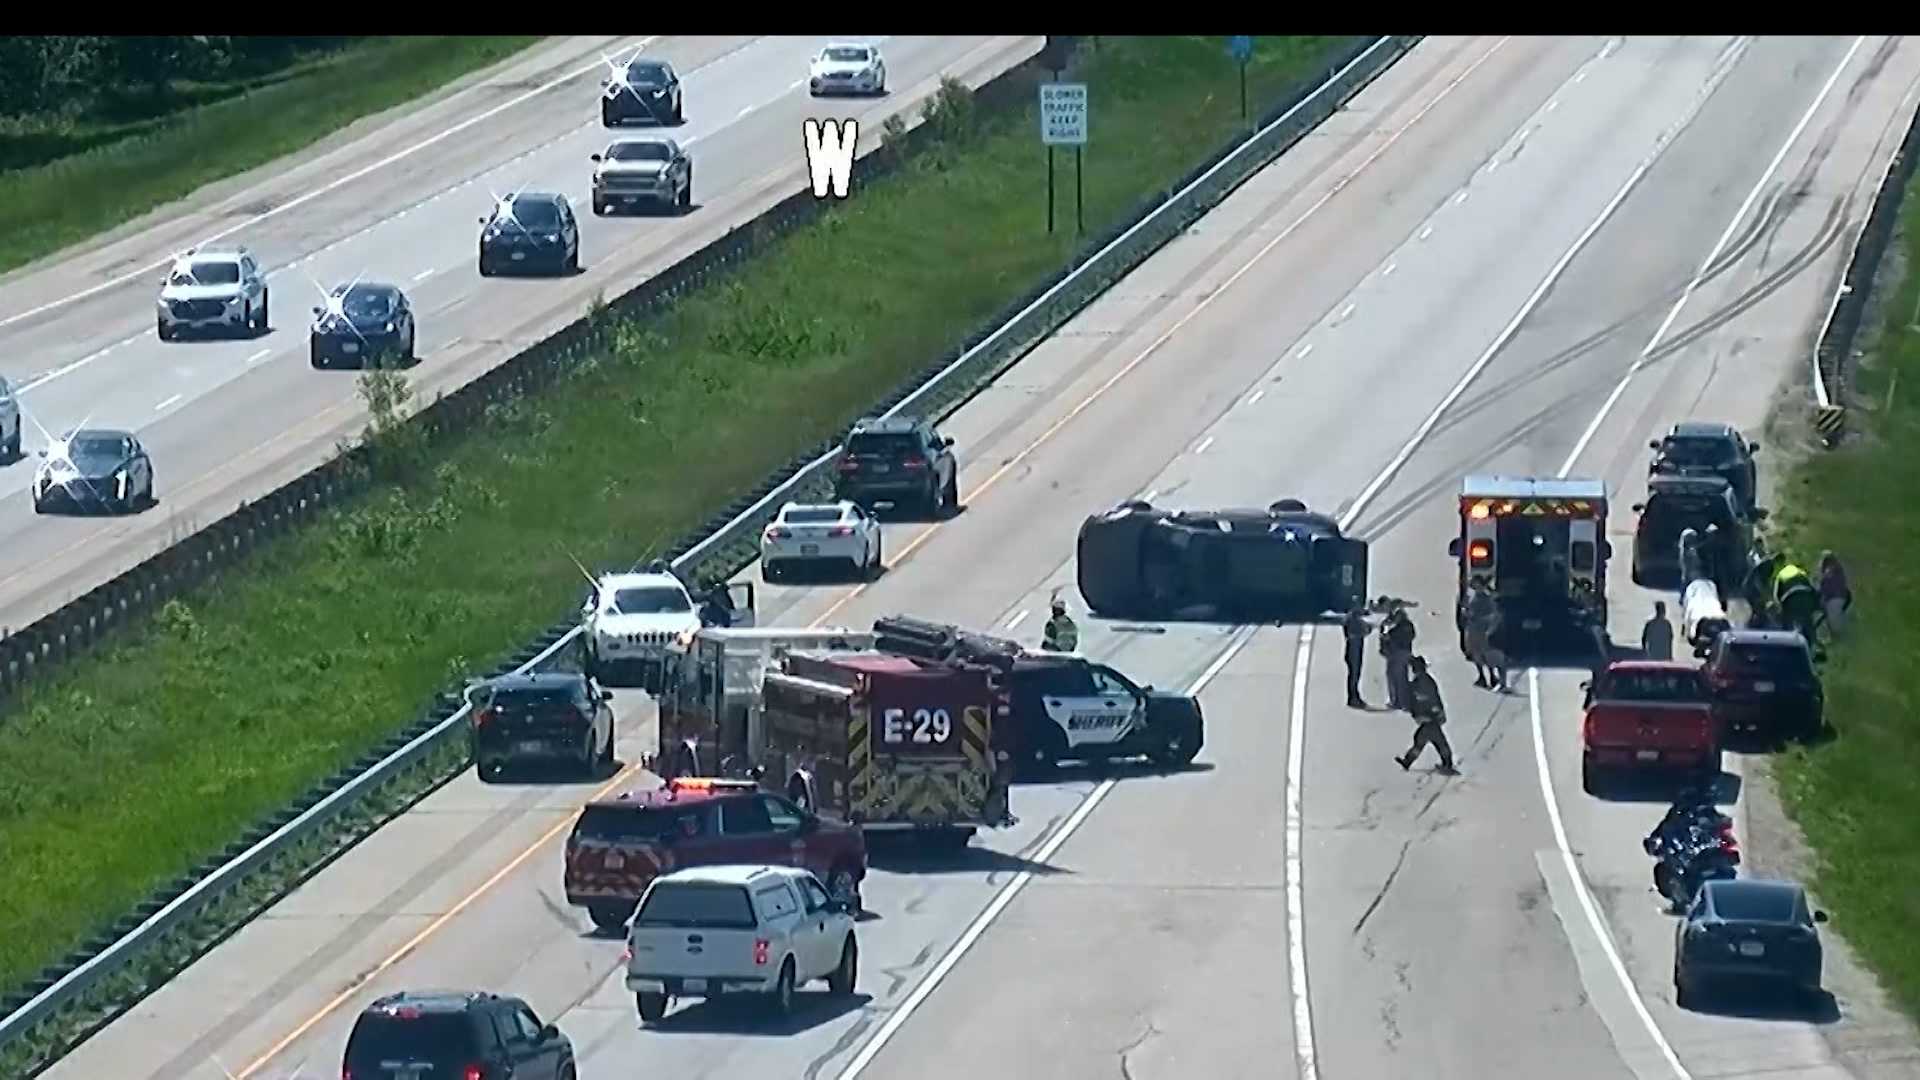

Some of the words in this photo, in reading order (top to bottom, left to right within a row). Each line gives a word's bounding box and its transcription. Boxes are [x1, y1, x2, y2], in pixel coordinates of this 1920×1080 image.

[1043, 90, 1084, 100] SLOWER
[1043, 103, 1084, 112] TRAFFIC
[1050, 115, 1078, 125] KEEP
[1049, 128, 1080, 137] RIGHT
[1068, 714, 1128, 730] SHERIFF
